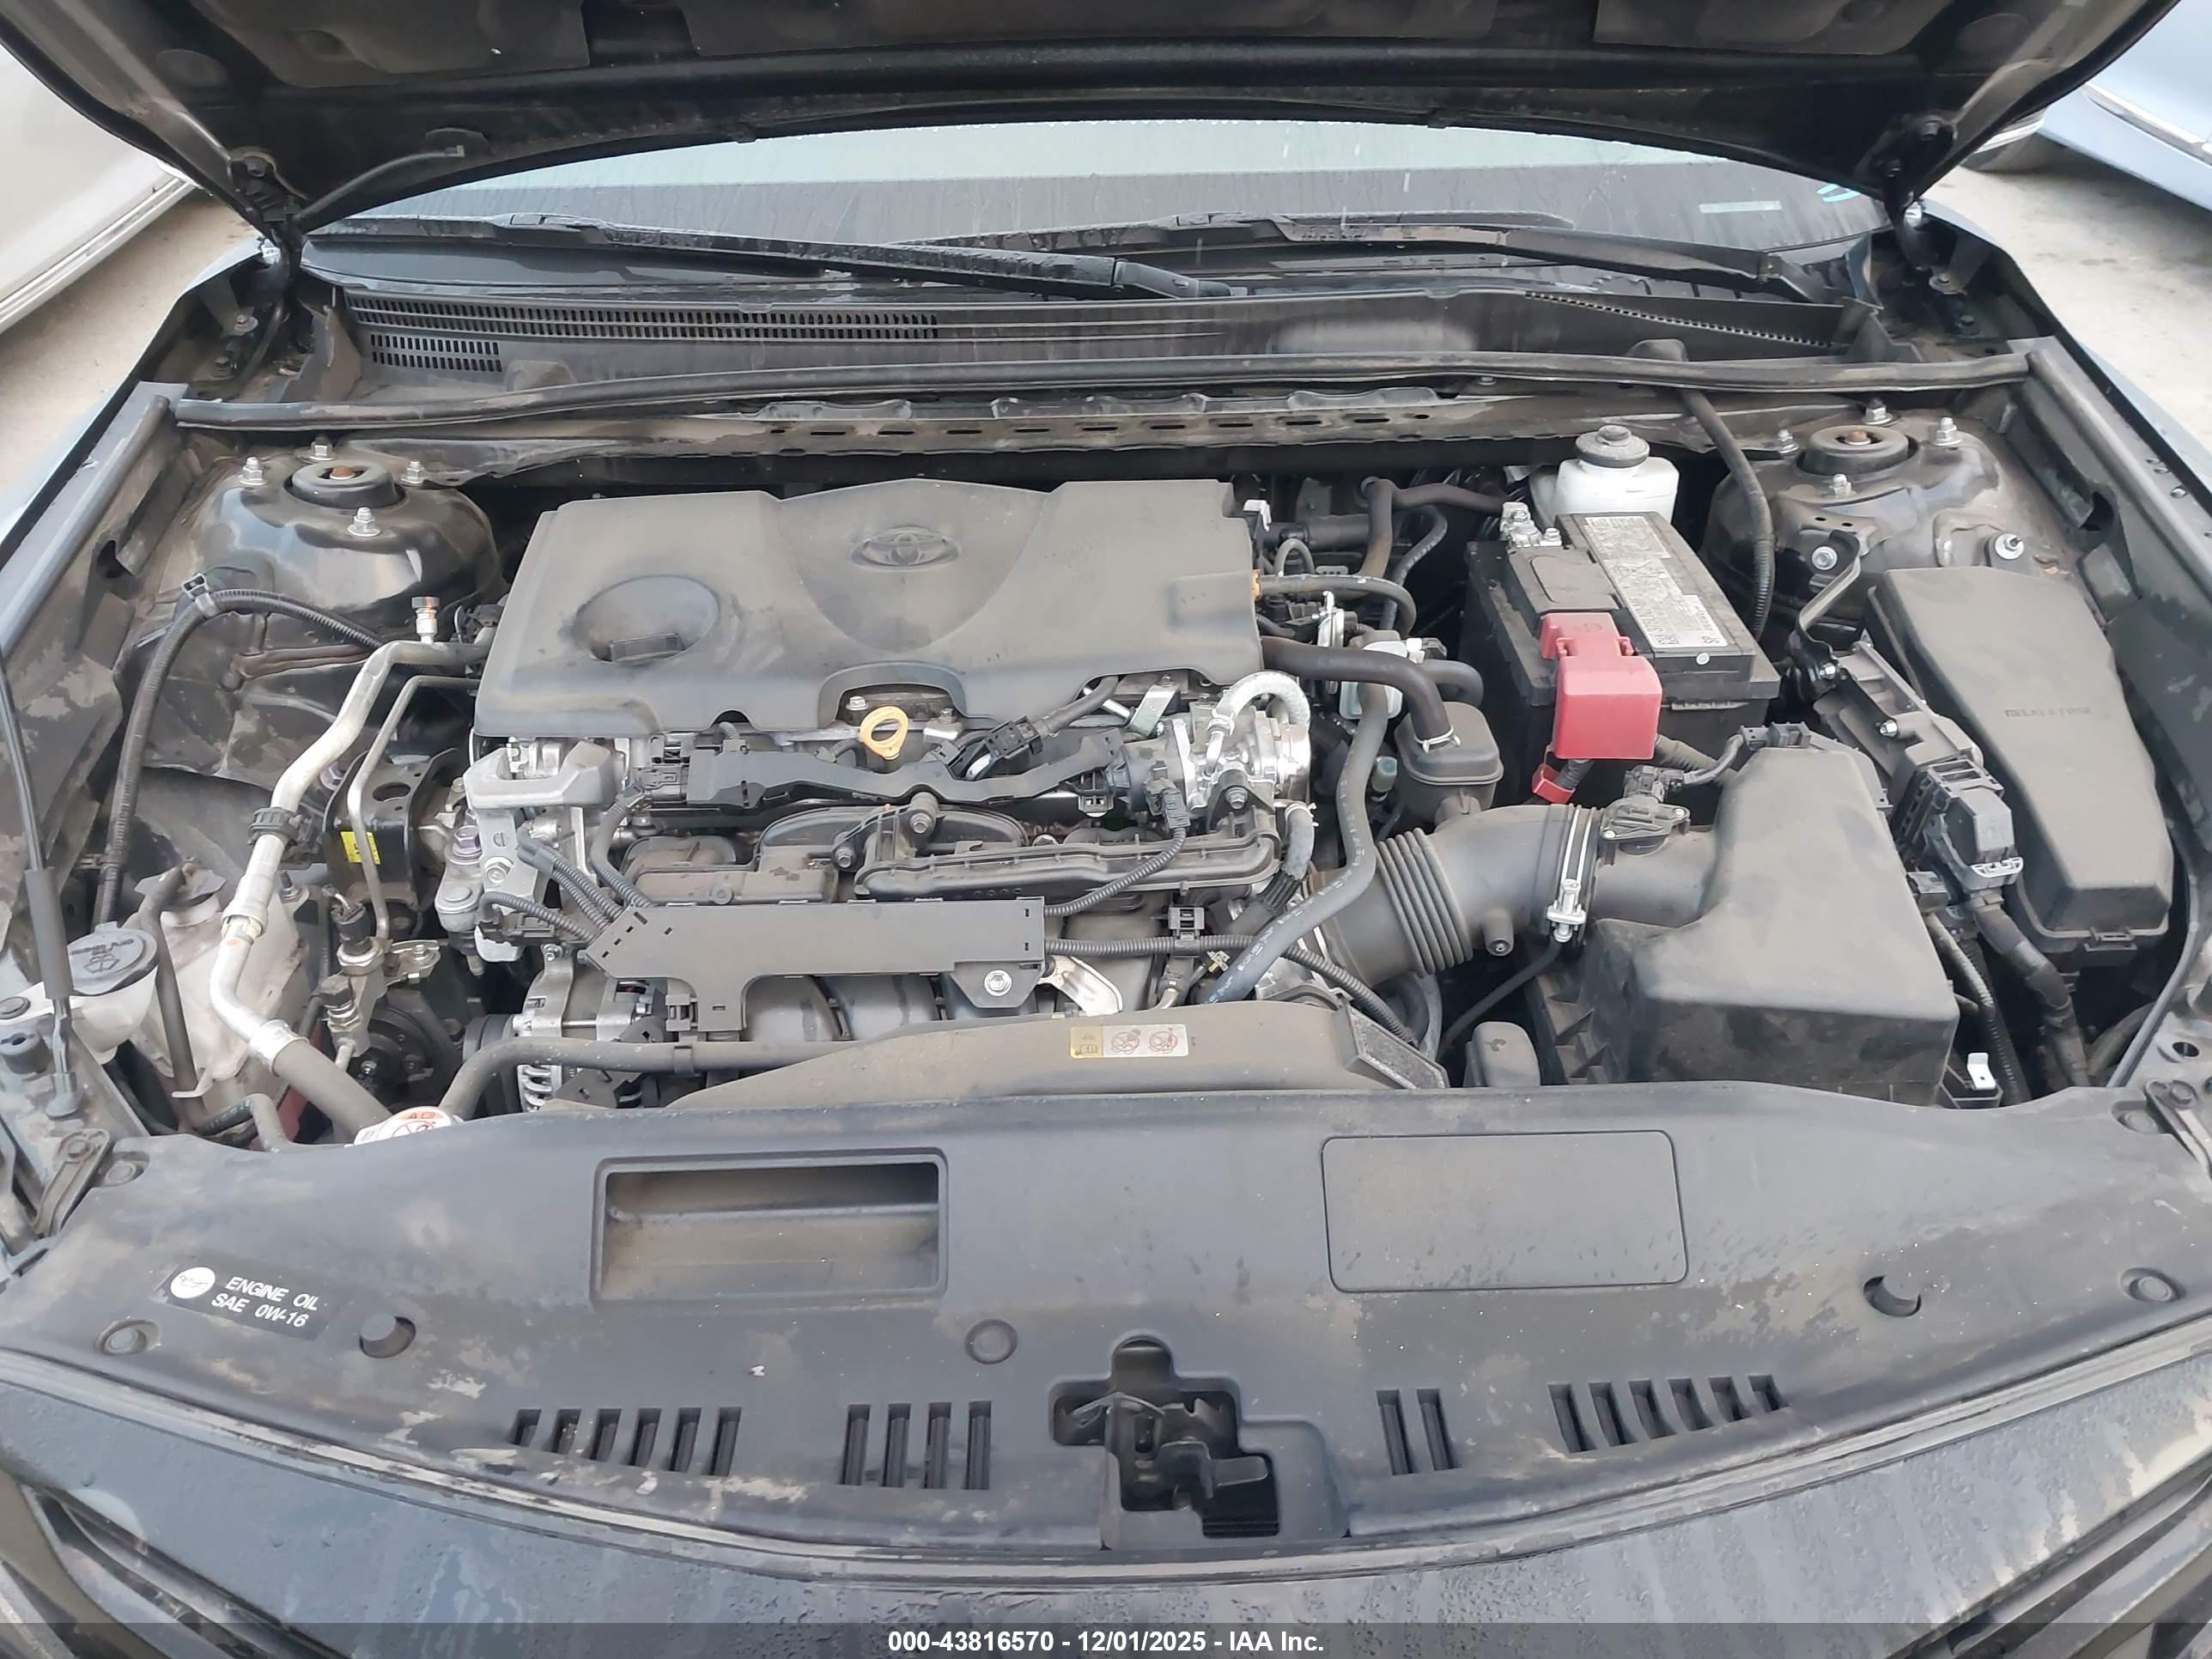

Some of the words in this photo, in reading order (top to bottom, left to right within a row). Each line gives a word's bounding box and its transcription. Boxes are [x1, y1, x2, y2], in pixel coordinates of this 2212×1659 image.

[211, 1292, 250, 1313] SAE
[254, 1304, 309, 1328] 0W-16
[225, 1276, 289, 1302] ENGINE
[293, 1293, 320, 1311] OIL
